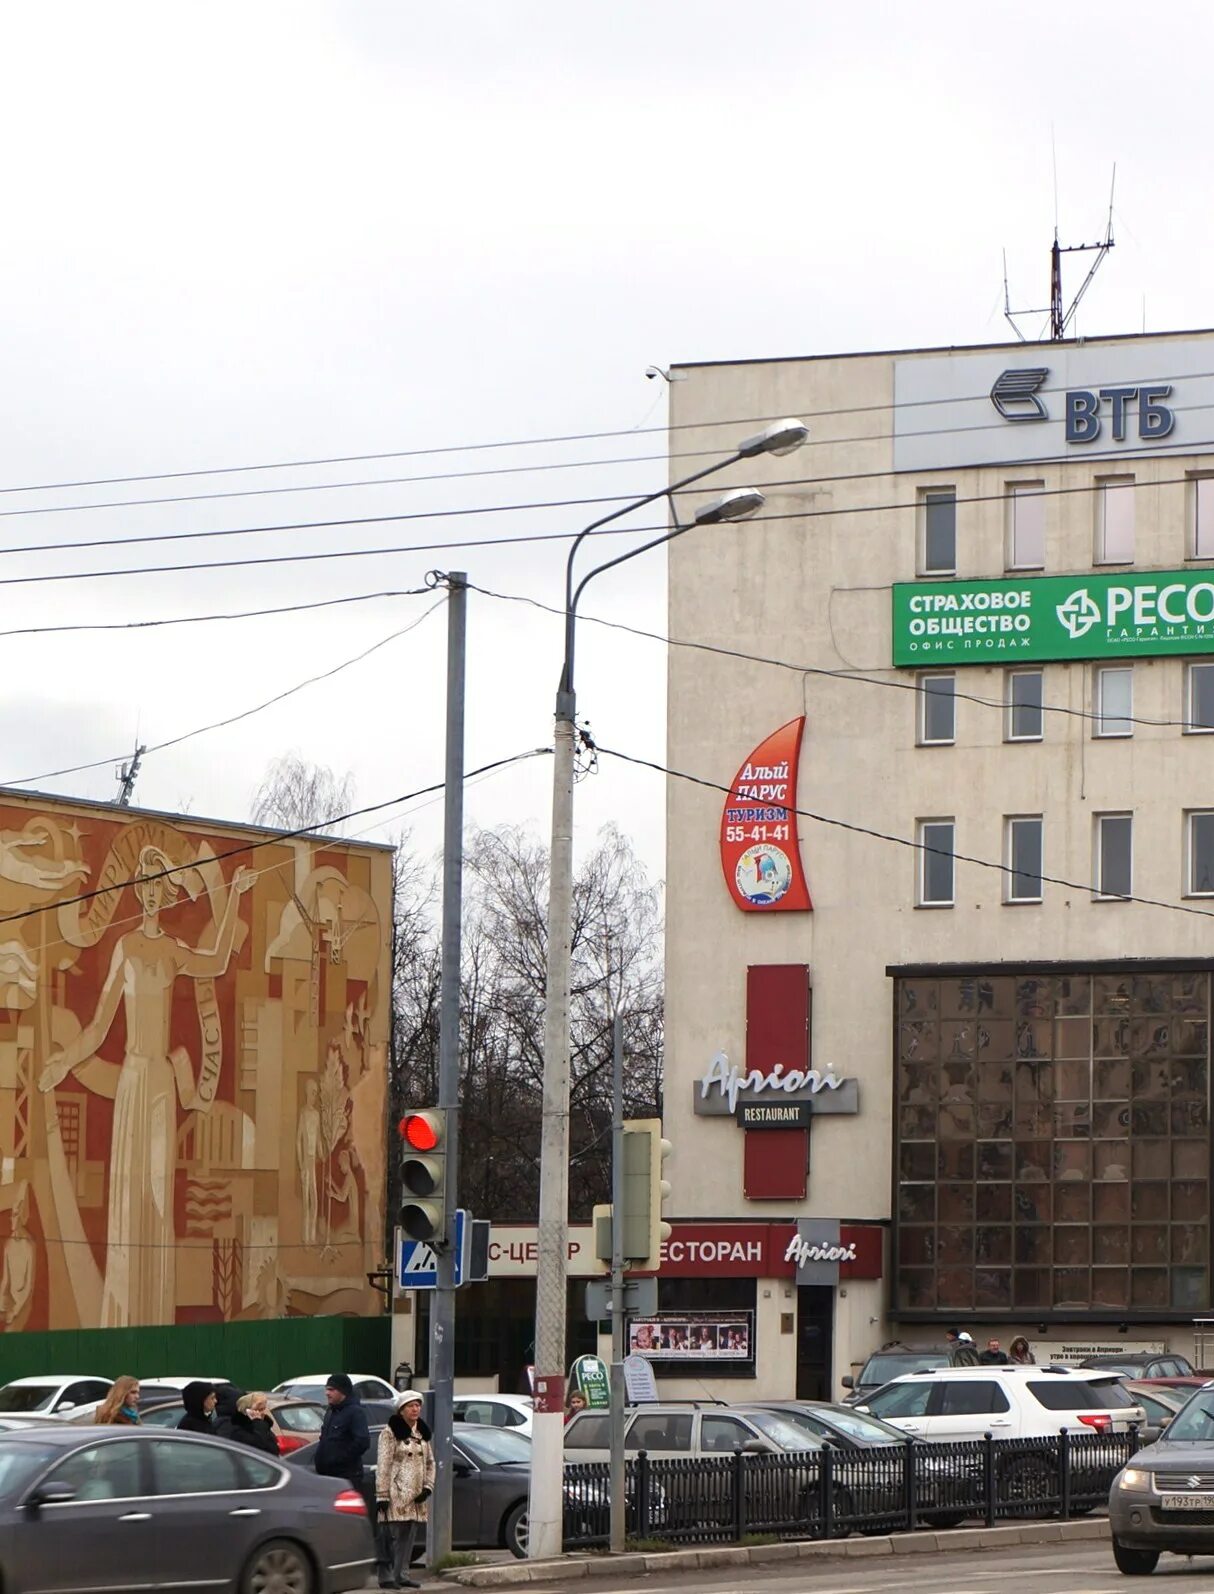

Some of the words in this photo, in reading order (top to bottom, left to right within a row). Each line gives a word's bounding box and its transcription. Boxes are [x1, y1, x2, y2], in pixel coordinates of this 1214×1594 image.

[1065, 385, 1175, 443] ВТБ
[909, 591, 1031, 613] СТРАХОВОЕ
[909, 614, 1031, 636] ОБЩЕСТВО
[909, 640, 954, 651] ОФИС
[964, 638, 1031, 648] ПРОДАЖ
[740, 761, 789, 780] Алый
[736, 784, 788, 801] ПАРУС
[727, 808, 788, 822] ТУРИЗМ
[726, 824, 789, 842] 55-41-41
[701, 1049, 845, 1114] Apriori
[744, 1107, 800, 1121] RESTAURANT
[488, 1242, 581, 1263] С-ЦЕР
[659, 1241, 762, 1262] ЕСТОРАН
[784, 1233, 857, 1269] Apriori
[581, 1371, 604, 1381] РЕСО
